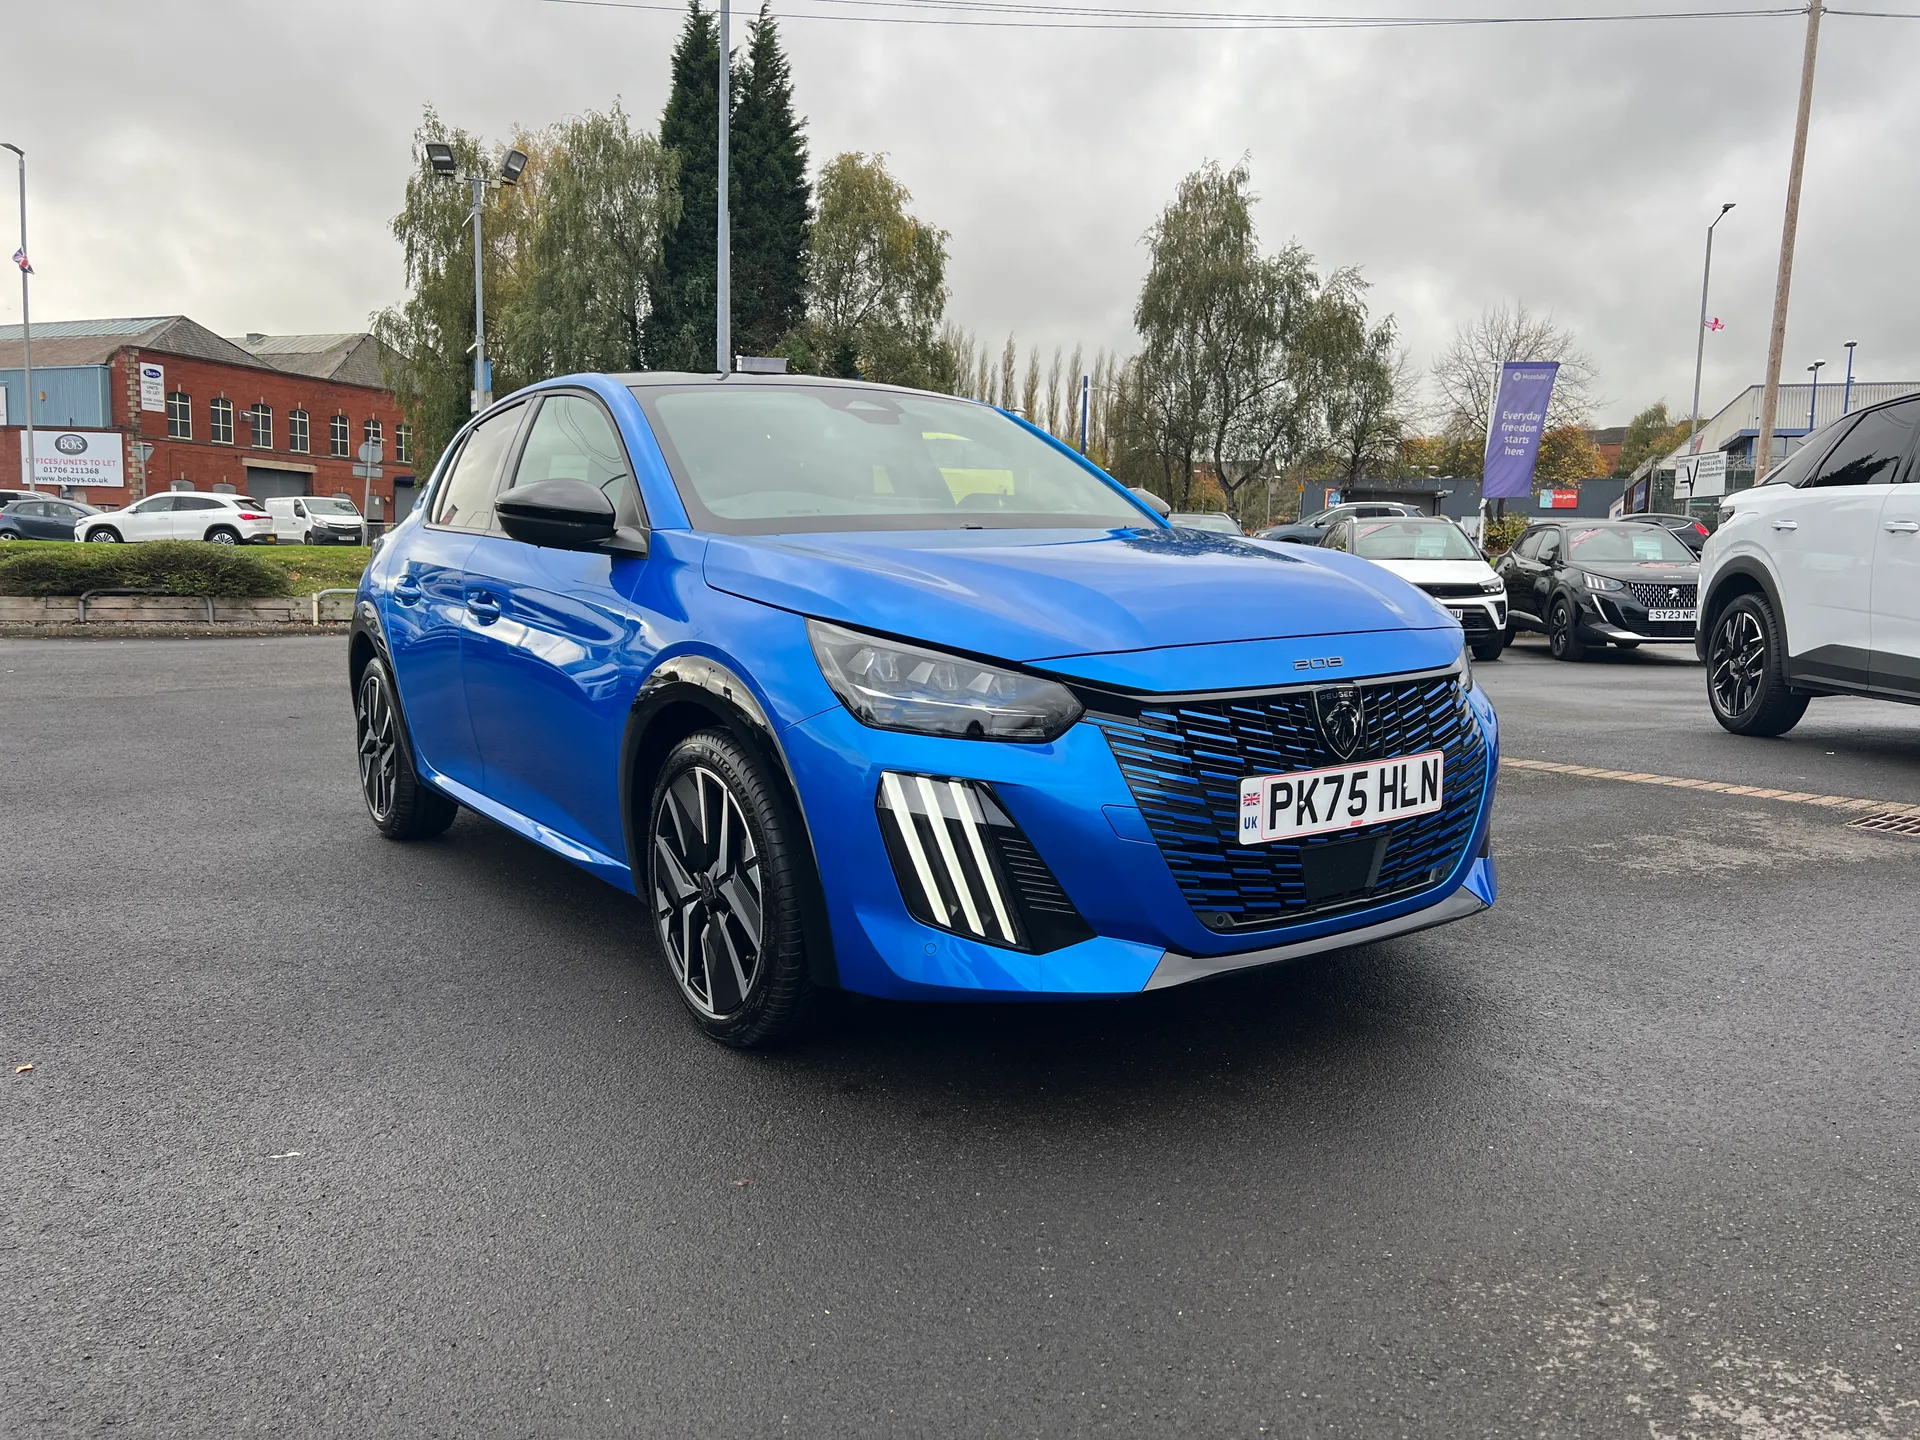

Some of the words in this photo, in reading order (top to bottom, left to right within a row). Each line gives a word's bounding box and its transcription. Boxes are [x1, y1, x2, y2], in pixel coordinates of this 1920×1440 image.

[1522, 373, 1550, 382] Motability
[1502, 410, 1542, 423] Everyday
[1501, 422, 1538, 433] freedom
[60, 438, 83, 450] BOYS
[1504, 435, 1530, 444] starts
[1504, 446, 1525, 456] here
[26, 457, 88, 466] OFICES/UNITS
[43, 466, 68, 474] 01706
[70, 467, 100, 475] 211368
[35, 475, 109, 484] www.beboys.co.uk
[1655, 610, 1681, 620] SY23
[1682, 610, 1698, 620] NF
[1293, 656, 1343, 671] 208
[1319, 690, 1359, 701] PEUGEOT
[1269, 770, 1368, 830] PK75
[1378, 758, 1438, 813] HLN
[1244, 815, 1258, 830] UK
